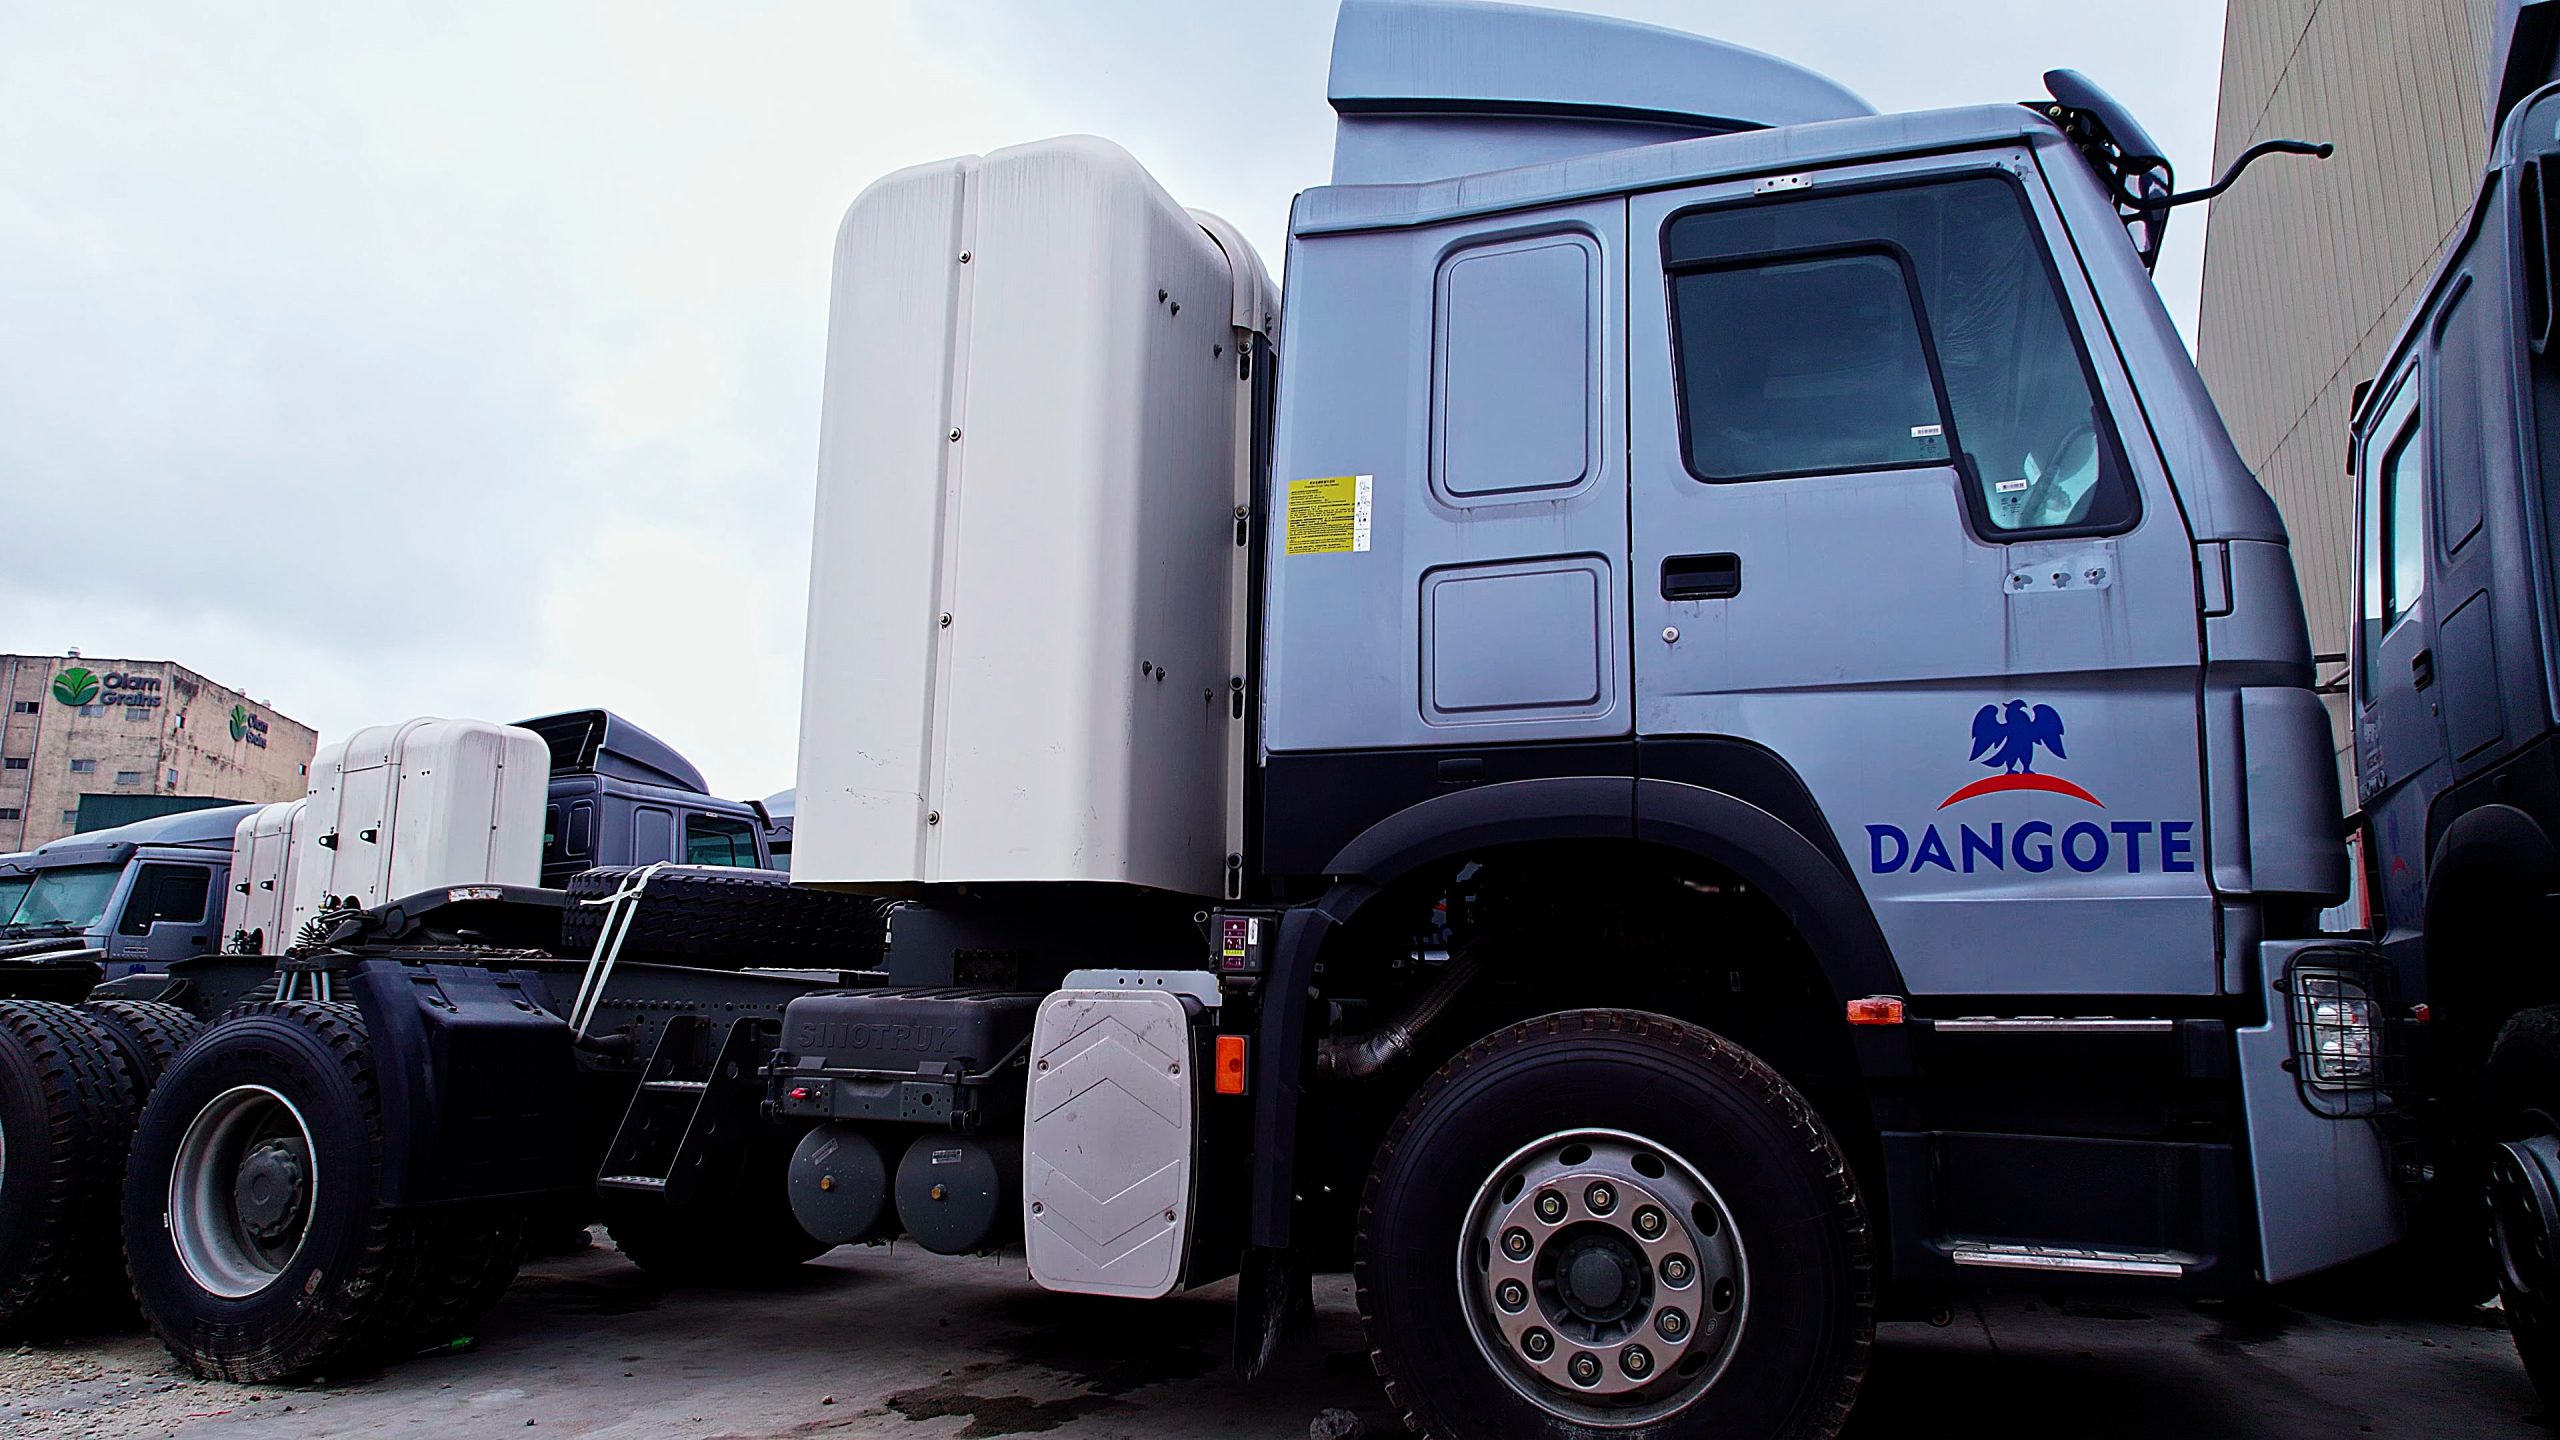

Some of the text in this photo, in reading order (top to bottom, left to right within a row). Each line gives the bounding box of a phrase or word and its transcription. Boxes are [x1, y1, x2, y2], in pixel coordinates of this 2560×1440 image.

[103, 672, 161, 690] Olam
[100, 690, 161, 707] Grains
[1864, 820, 2195, 874] DANGOTE
[799, 1022, 958, 1053] SINOTRUK
